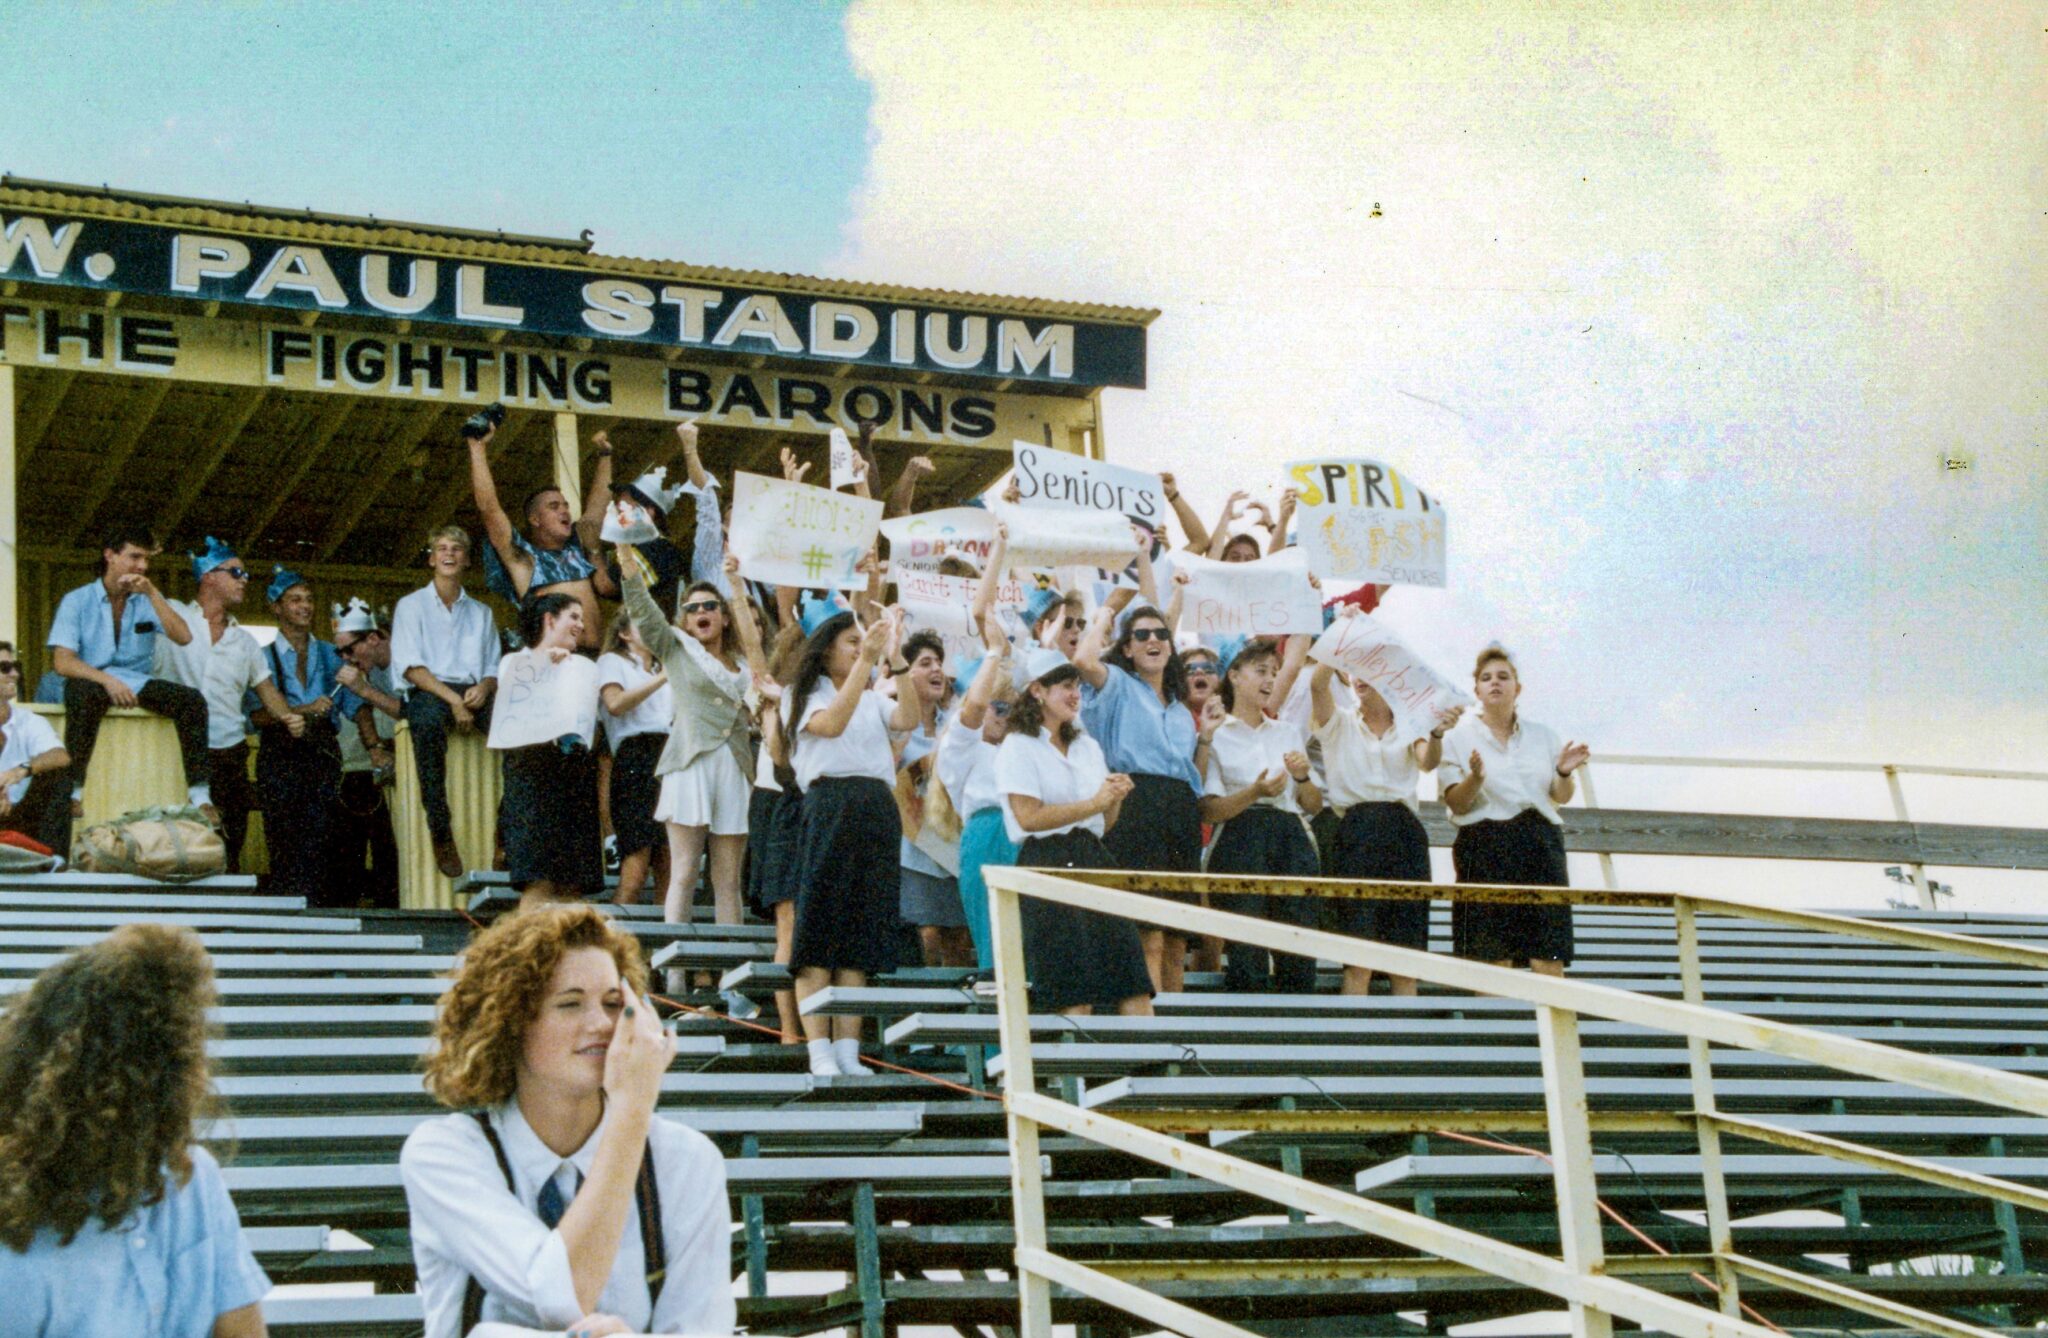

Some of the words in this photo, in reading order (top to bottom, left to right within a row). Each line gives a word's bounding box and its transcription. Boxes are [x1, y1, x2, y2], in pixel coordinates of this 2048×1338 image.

[171, 233, 525, 325] PAUL
[581, 279, 1076, 379] STADIUM
[266, 328, 614, 407] FIGHTING
[663, 367, 998, 440] BARONS
[1014, 448, 1156, 517] Seniors
